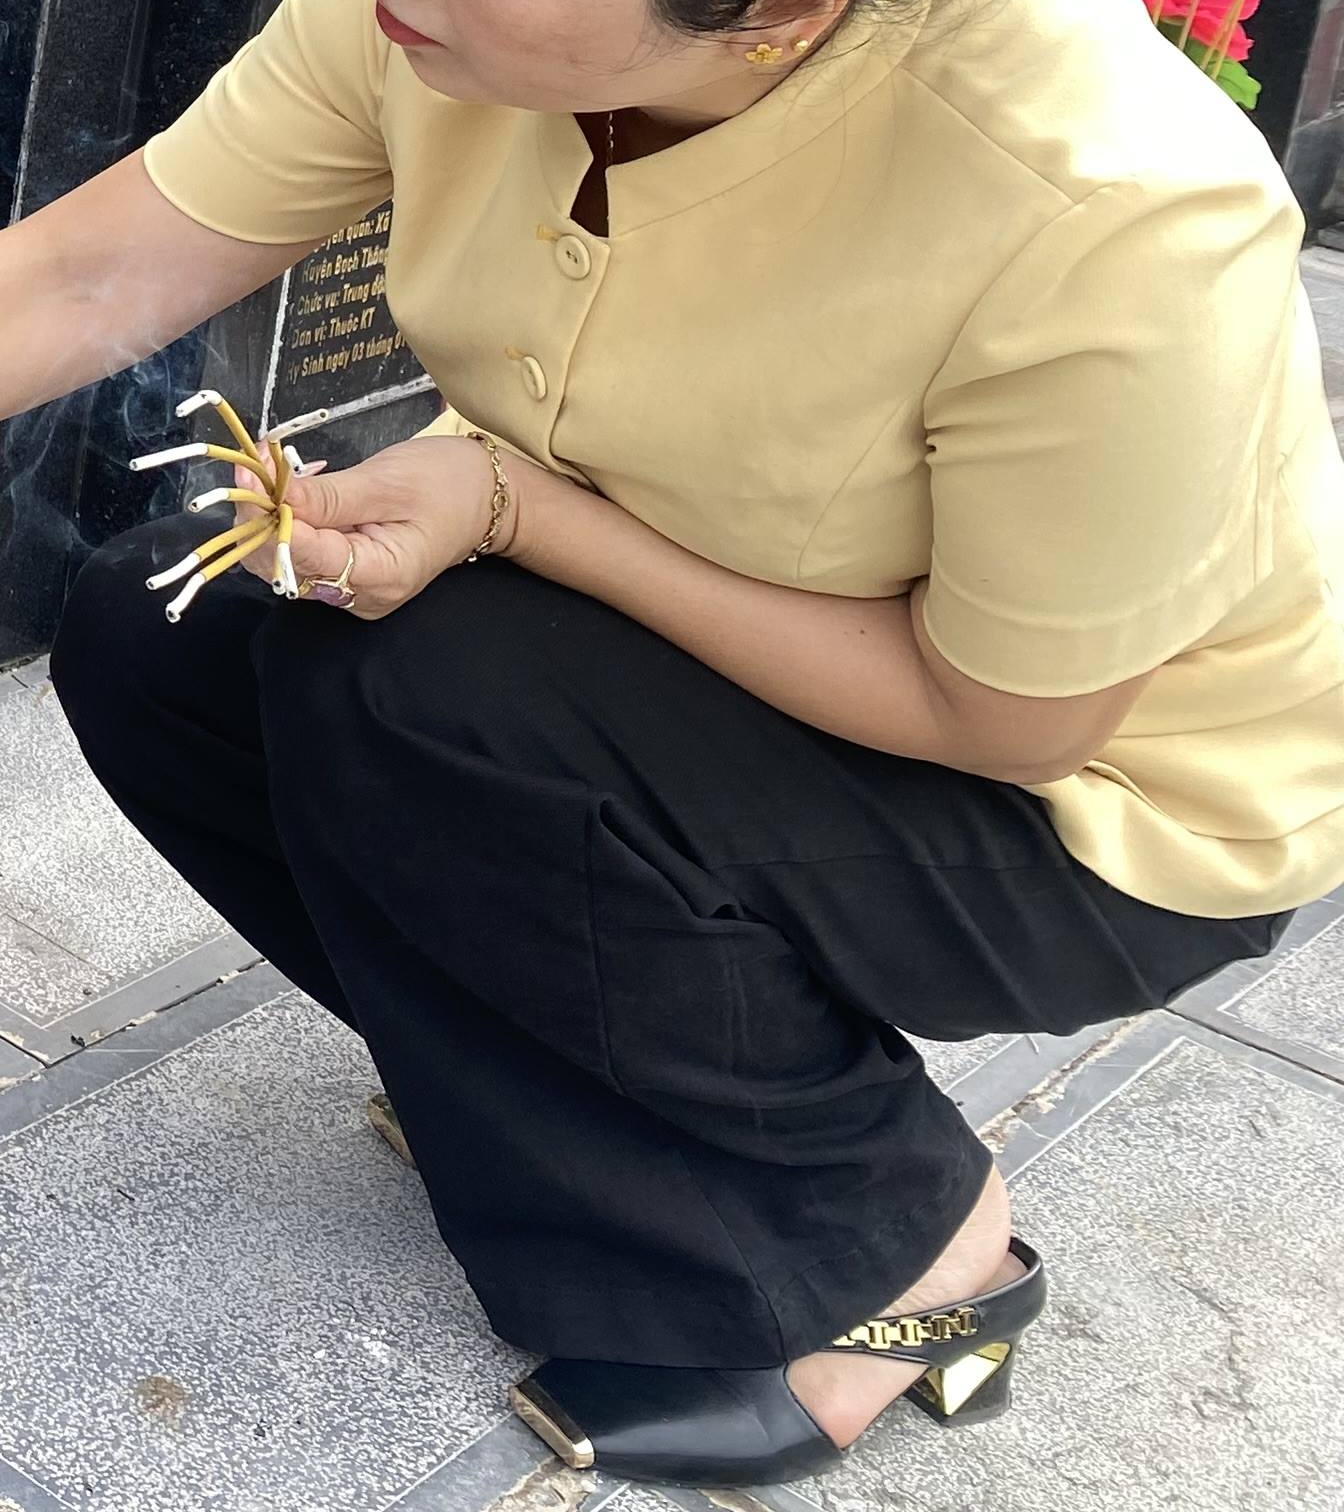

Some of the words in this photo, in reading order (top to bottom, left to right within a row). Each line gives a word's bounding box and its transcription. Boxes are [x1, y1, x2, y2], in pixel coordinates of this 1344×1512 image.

[334, 250, 358, 280] Bạch
[342, 281, 370, 304] Trung
[360, 307, 376, 329] KT
[301, 352, 323, 377] Sinh
[325, 346, 350, 374] ngày
[366, 333, 394, 357] tháng
